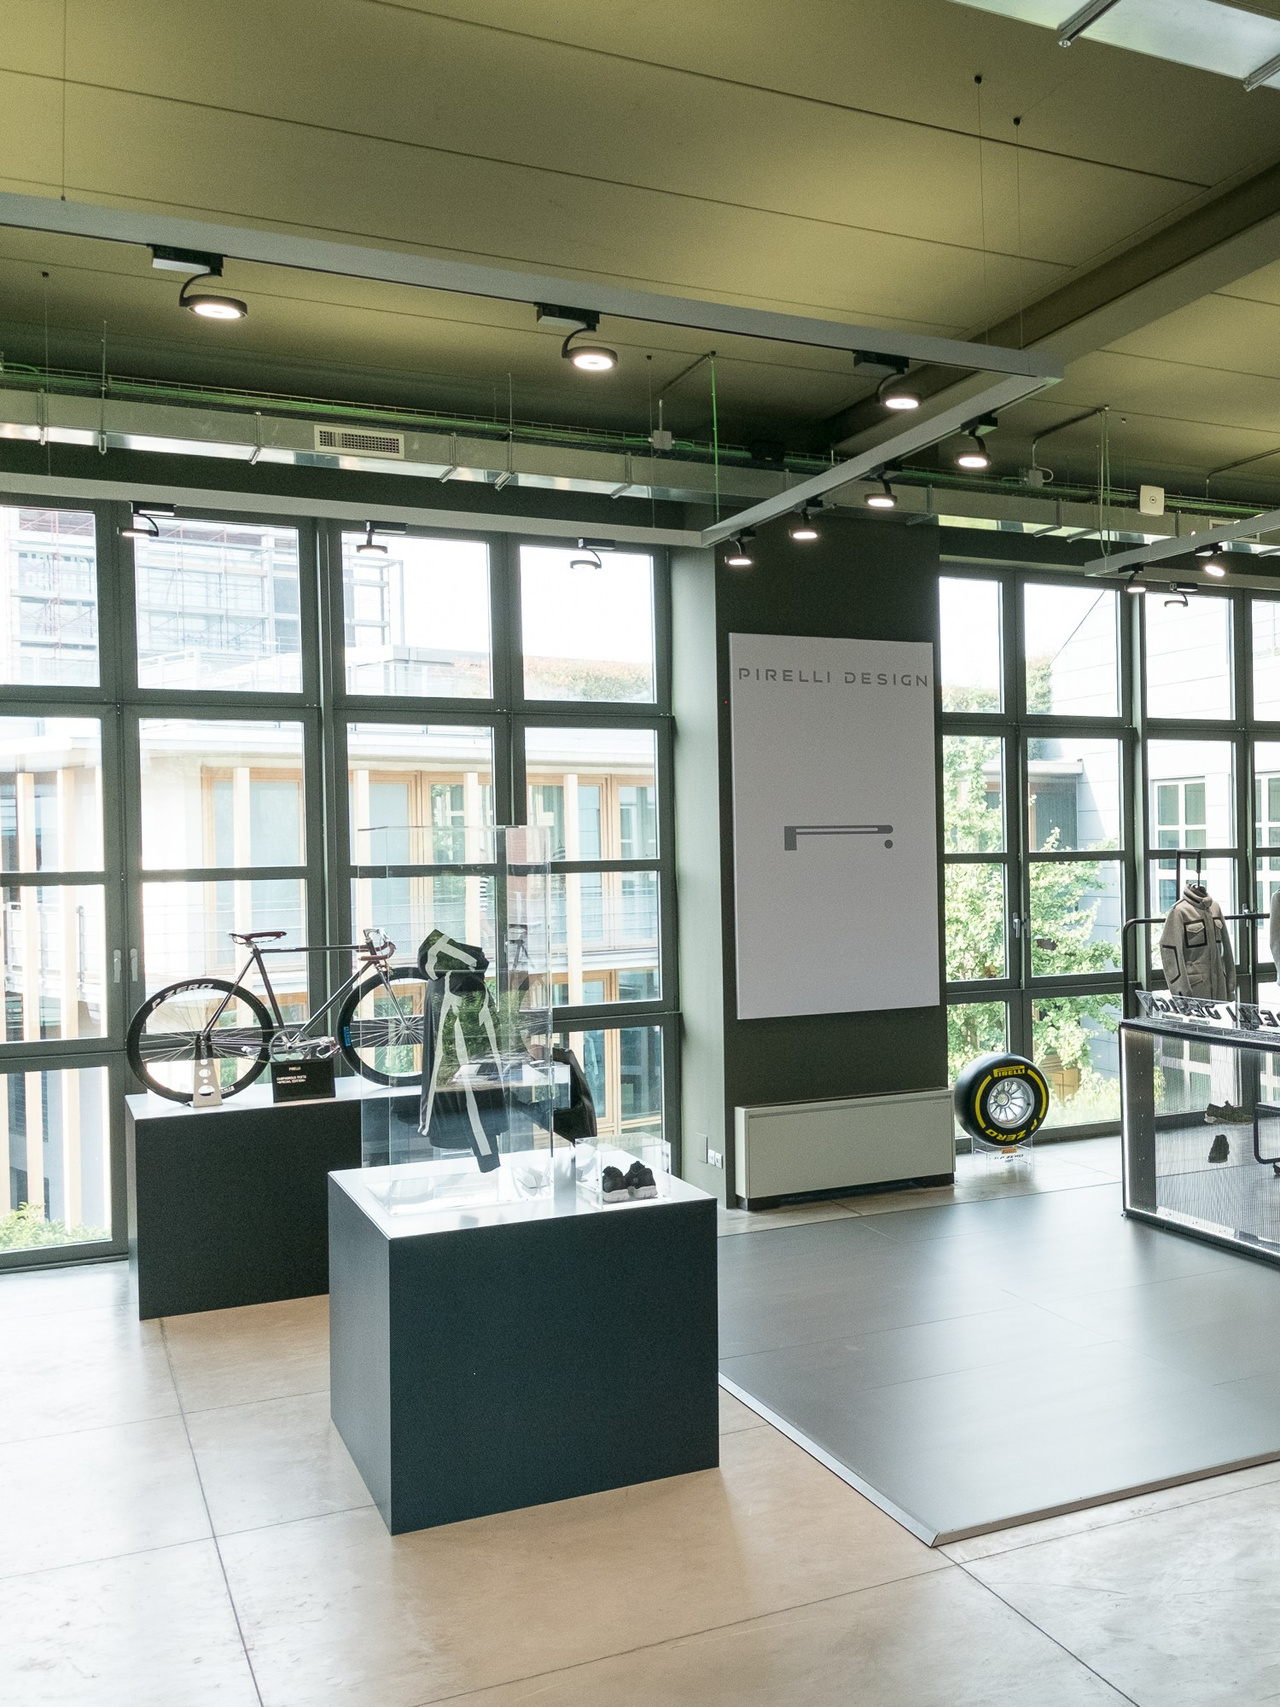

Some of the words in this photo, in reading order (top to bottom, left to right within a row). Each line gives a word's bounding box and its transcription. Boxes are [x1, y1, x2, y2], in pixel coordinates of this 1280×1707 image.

[738, 667, 831, 684] PIRELLI
[844, 671, 929, 688] DESIGN
[164, 983, 214, 999] ZERO
[993, 1065, 1025, 1078] PIRELLI
[985, 1128, 1027, 1142] ZERO
